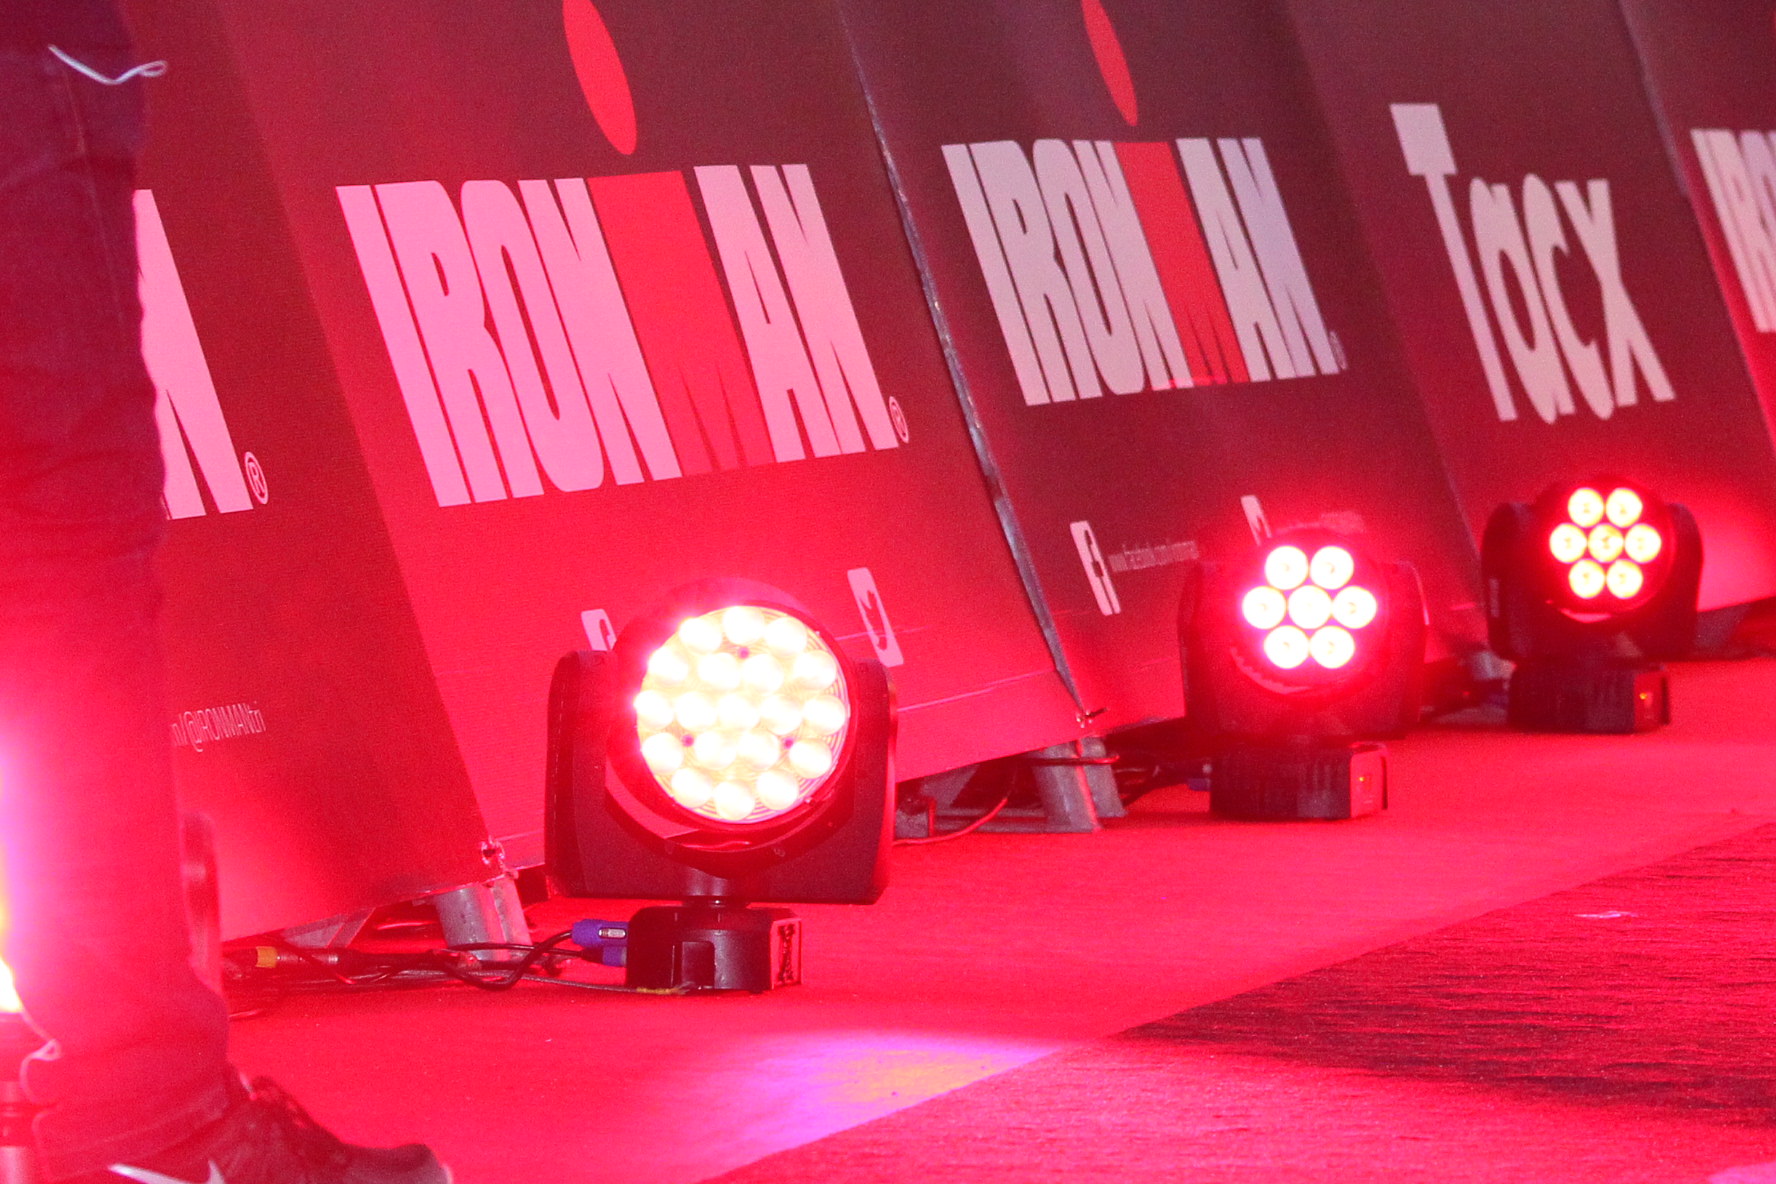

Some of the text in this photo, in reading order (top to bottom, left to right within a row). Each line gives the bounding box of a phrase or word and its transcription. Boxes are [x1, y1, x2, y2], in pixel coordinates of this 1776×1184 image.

[336, 163, 900, 507] IRONMAN
[941, 136, 1340, 407] IRONMAN
[1389, 103, 1676, 425] Tacx
